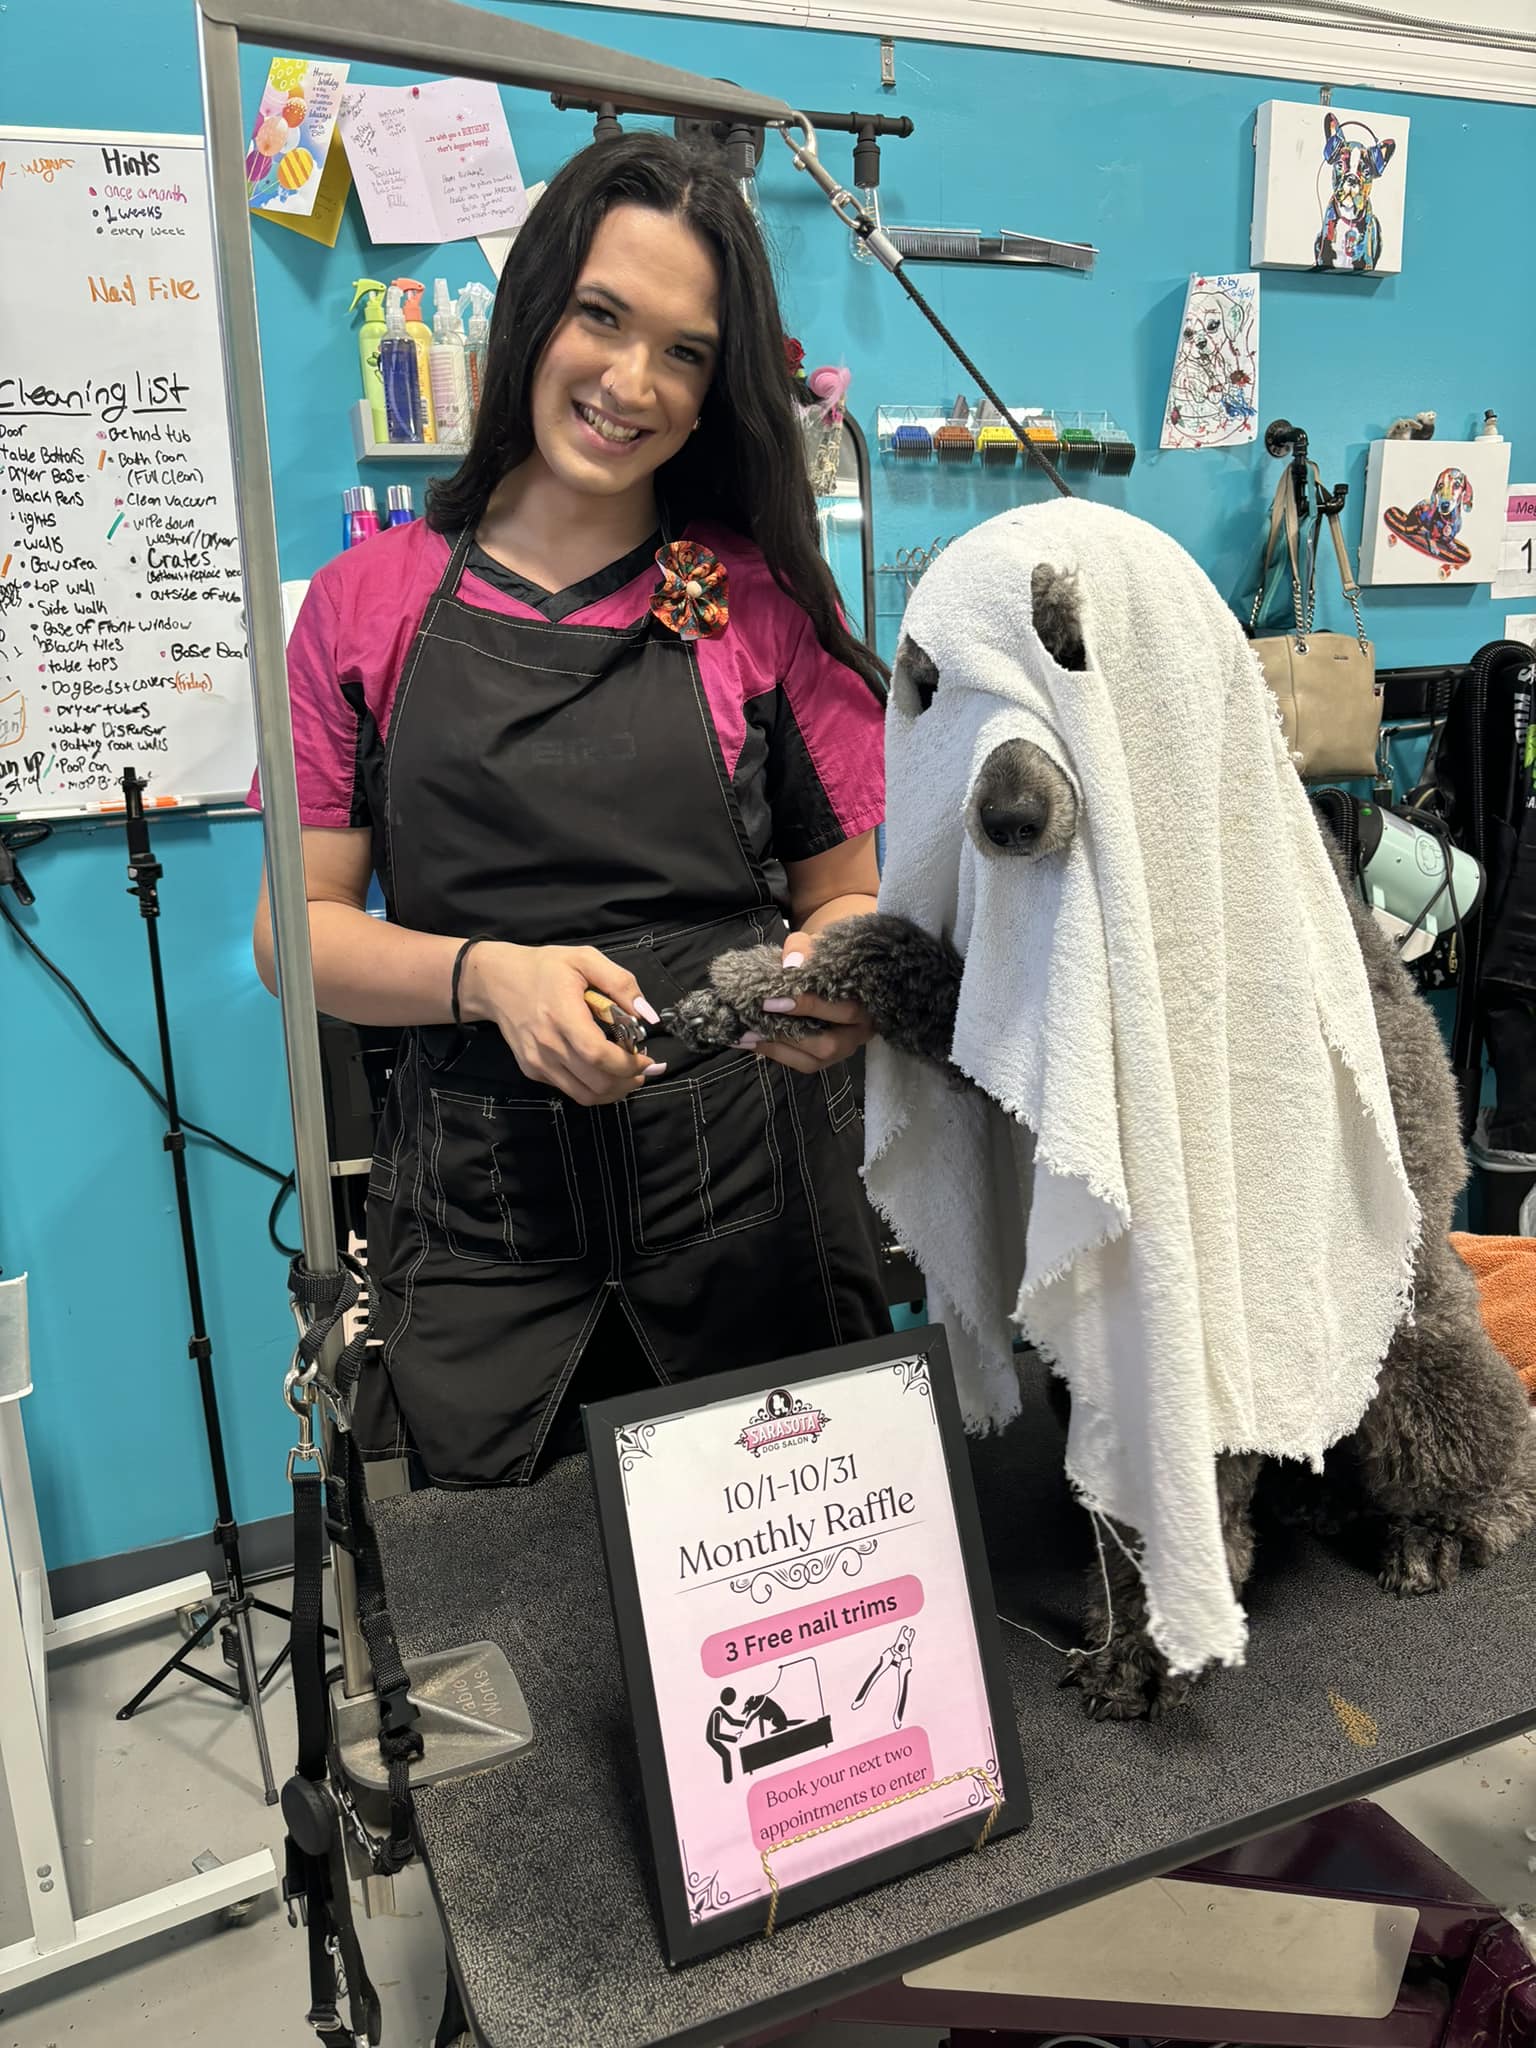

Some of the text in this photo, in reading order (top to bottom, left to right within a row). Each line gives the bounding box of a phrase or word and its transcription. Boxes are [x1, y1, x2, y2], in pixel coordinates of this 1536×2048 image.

[102, 148, 161, 176] Hints
[104, 185, 133, 201] once
[118, 206, 163, 220] weeks
[110, 226, 186, 239] every week
[148, 276, 200, 301] File
[0, 378, 127, 423] Cleaning
[12, 487, 52, 504] Black
[18, 511, 57, 535] lights
[749, 1414, 816, 1446] SARASOTA
[762, 1436, 809, 1454] DOG SALON
[679, 1486, 917, 1579] Monthly Raffle
[725, 1595, 898, 1662] 3 Free nail trims
[766, 1745, 913, 1808] Book your next two
[759, 1767, 928, 1842] appointments to enter
